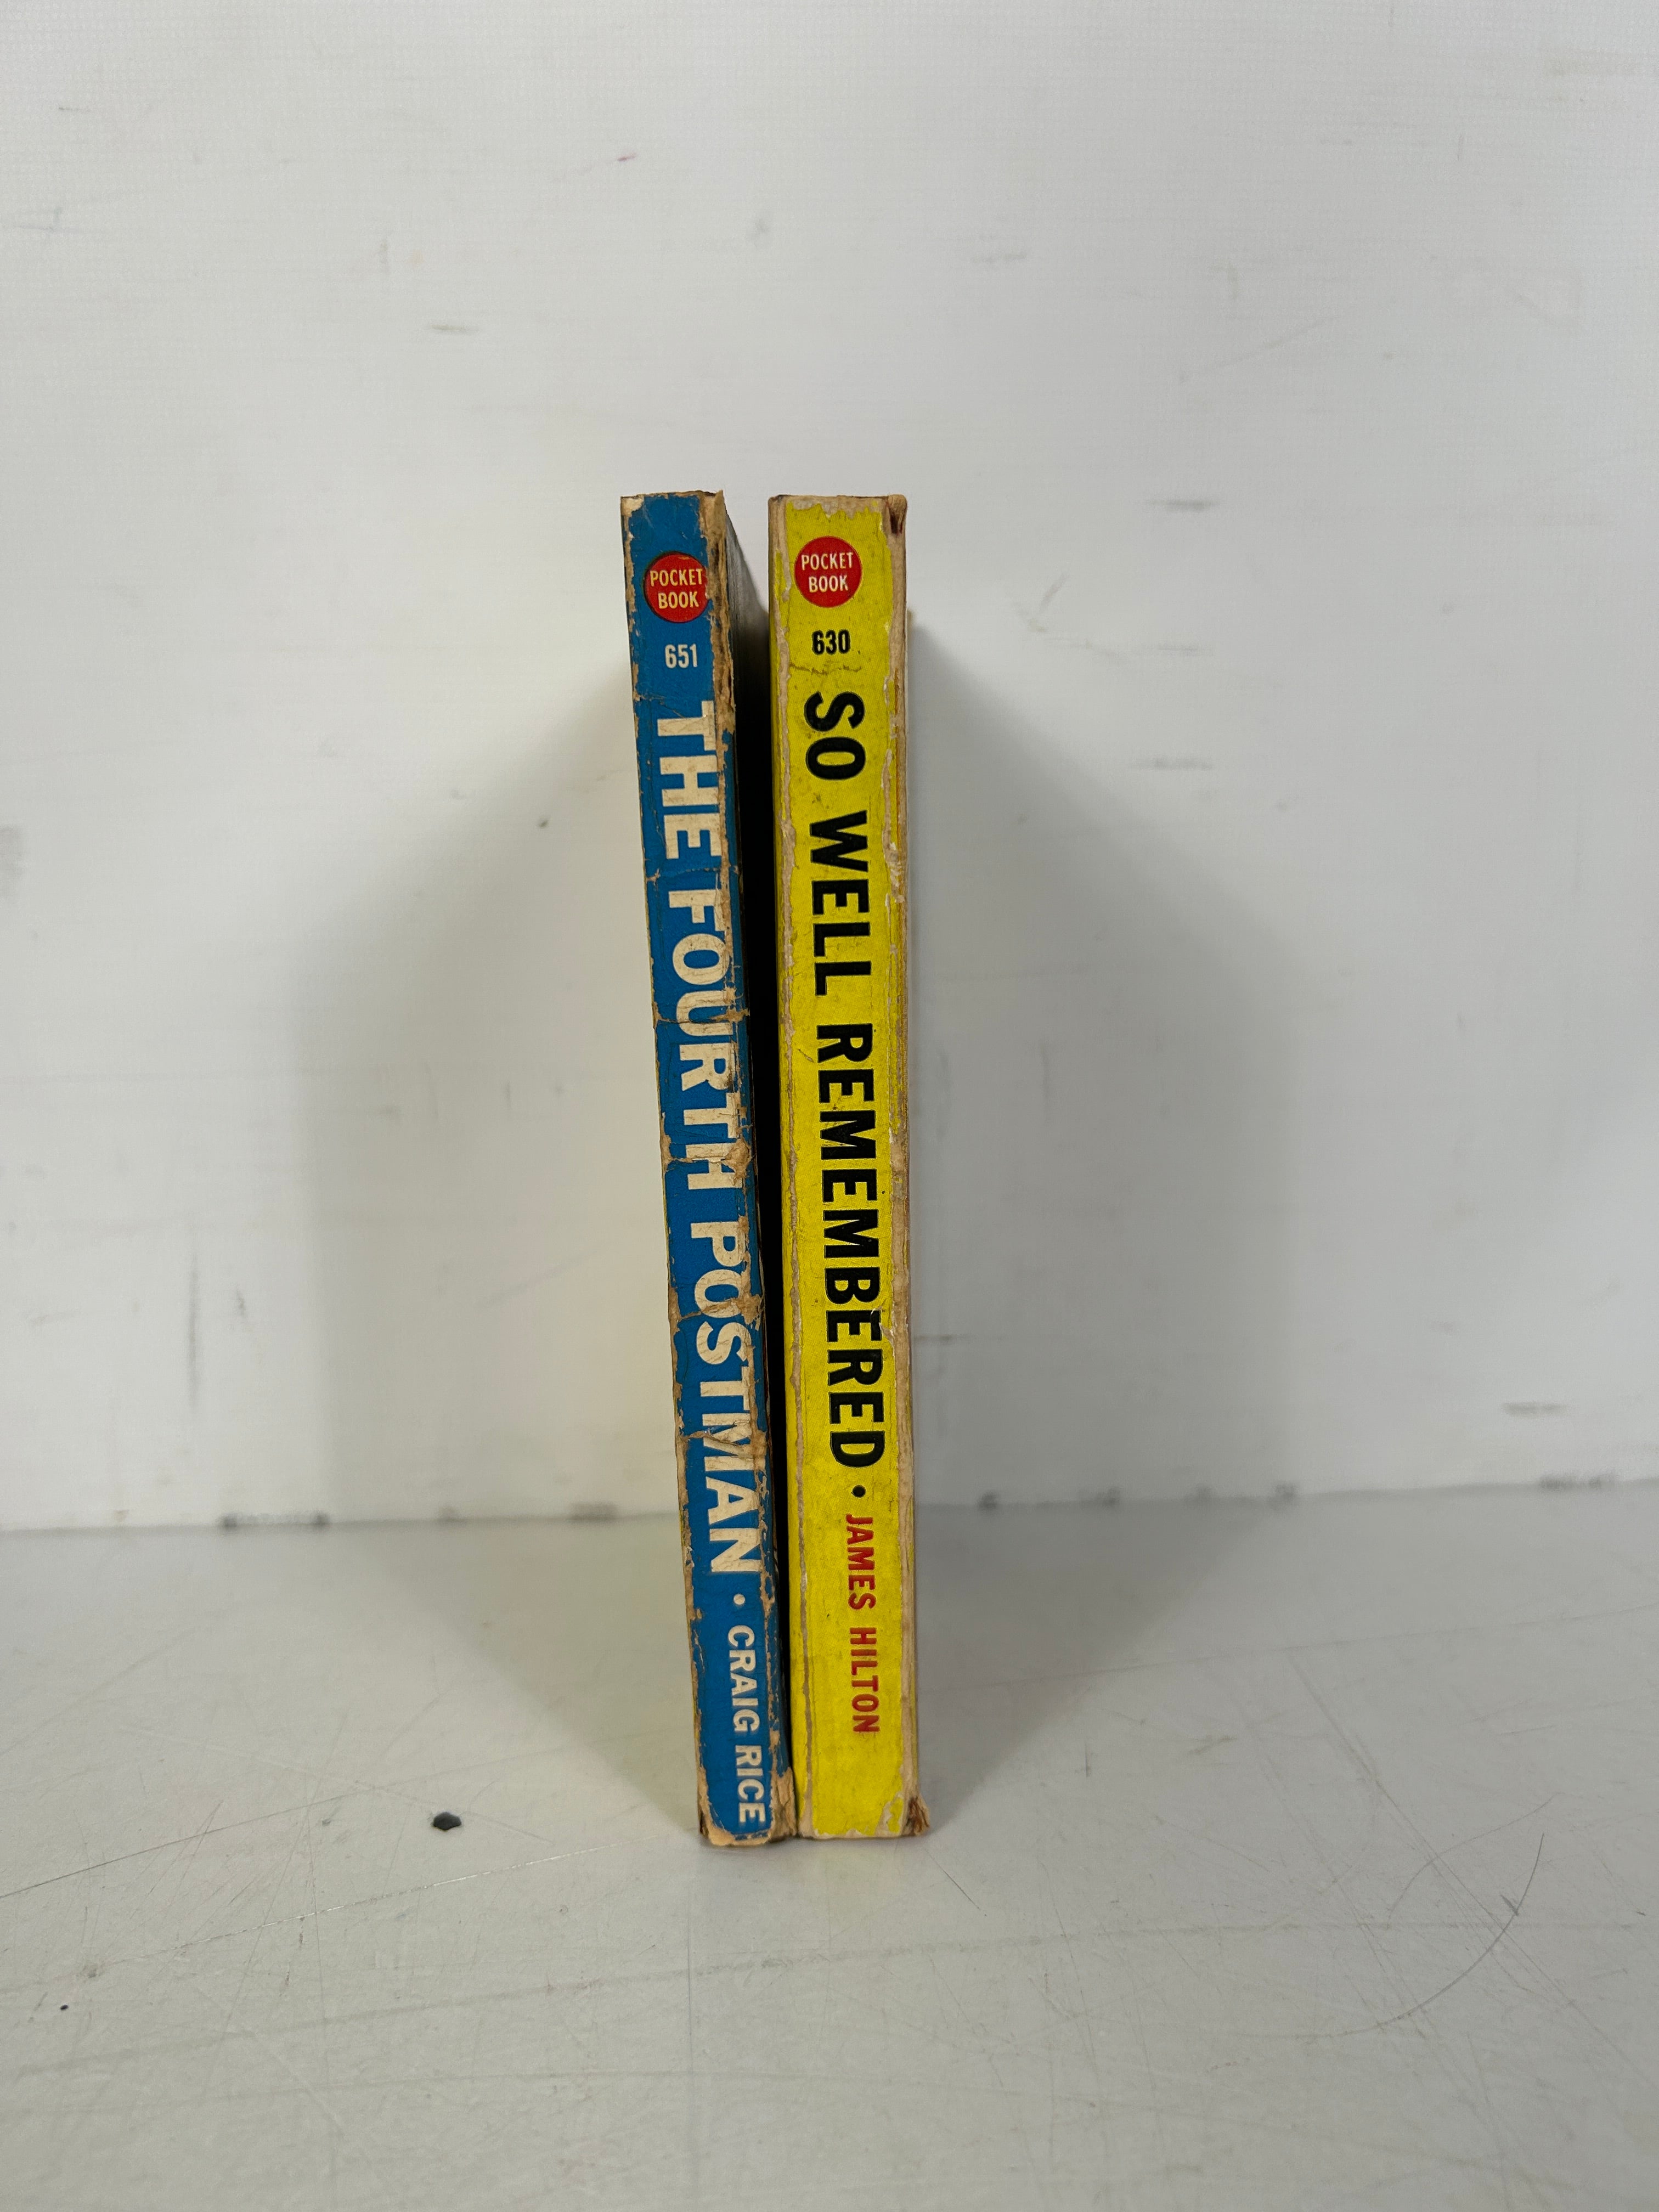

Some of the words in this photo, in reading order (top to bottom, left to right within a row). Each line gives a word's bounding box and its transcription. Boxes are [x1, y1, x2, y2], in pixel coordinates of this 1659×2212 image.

[650, 568, 703, 587] POCKET
[658, 591, 699, 609] BOOK
[801, 552, 854, 571] POCKET
[809, 575, 849, 593] BOOK
[664, 644, 698, 669] 651
[811, 629, 851, 656] 630
[657, 701, 722, 860] THE
[804, 691, 866, 781] SO
[809, 810, 871, 996] WELL
[668, 888, 743, 1190] FOURTH
[816, 1023, 886, 1468] REMEMBERED
[690, 1221, 761, 1572] POSTMAN
[845, 1513, 877, 1611] JAMES
[727, 1624, 760, 1733] CRAIG
[849, 1627, 881, 1734] HILTON
[734, 1745, 766, 1823] RICE
